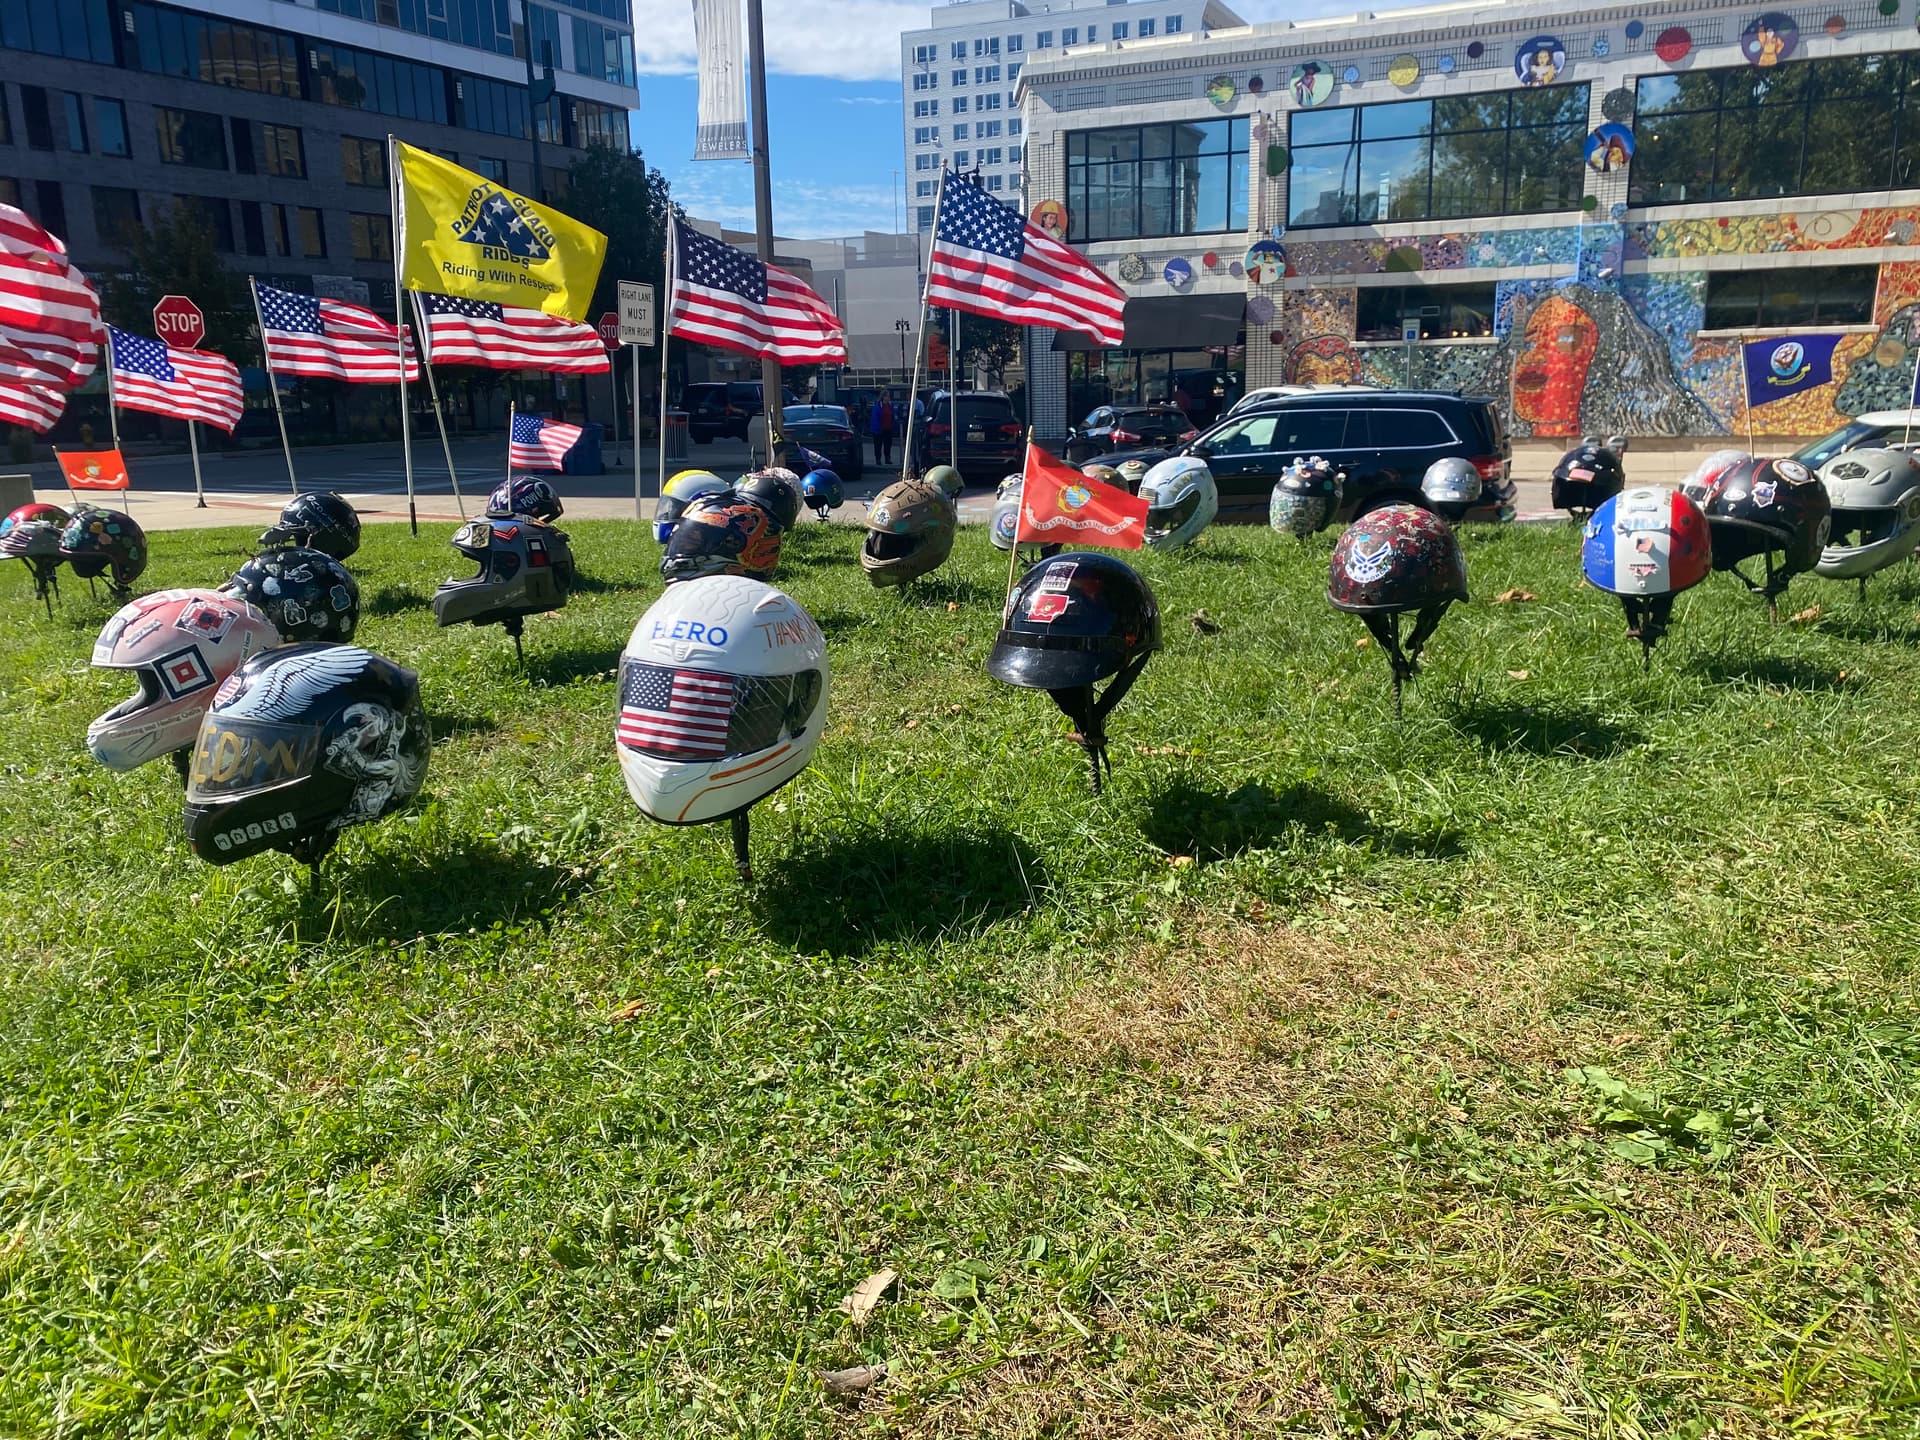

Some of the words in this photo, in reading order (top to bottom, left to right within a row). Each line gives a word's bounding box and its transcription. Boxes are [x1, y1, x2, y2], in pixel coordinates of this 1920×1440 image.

[696, 141, 747, 152] JEWELERS
[451, 182, 493, 235] PATRIOT
[512, 197, 556, 248] GUARD
[442, 261, 485, 281] Riding
[489, 269, 516, 283] With
[621, 289, 637, 300] RIGHT
[638, 291, 652, 303] LANE
[627, 307, 646, 320] MUST
[158, 313, 200, 333] STOP
[622, 325, 636, 336] TURN
[637, 327, 652, 337] RIGHT
[601, 324, 619, 339] STO
[520, 491, 539, 508] POW
[1049, 518, 1073, 528] STATES
[1075, 520, 1104, 531] MARINE
[1105, 521, 1129, 534] CORPS
[651, 620, 728, 647] HERO
[194, 726, 297, 784] EDM
